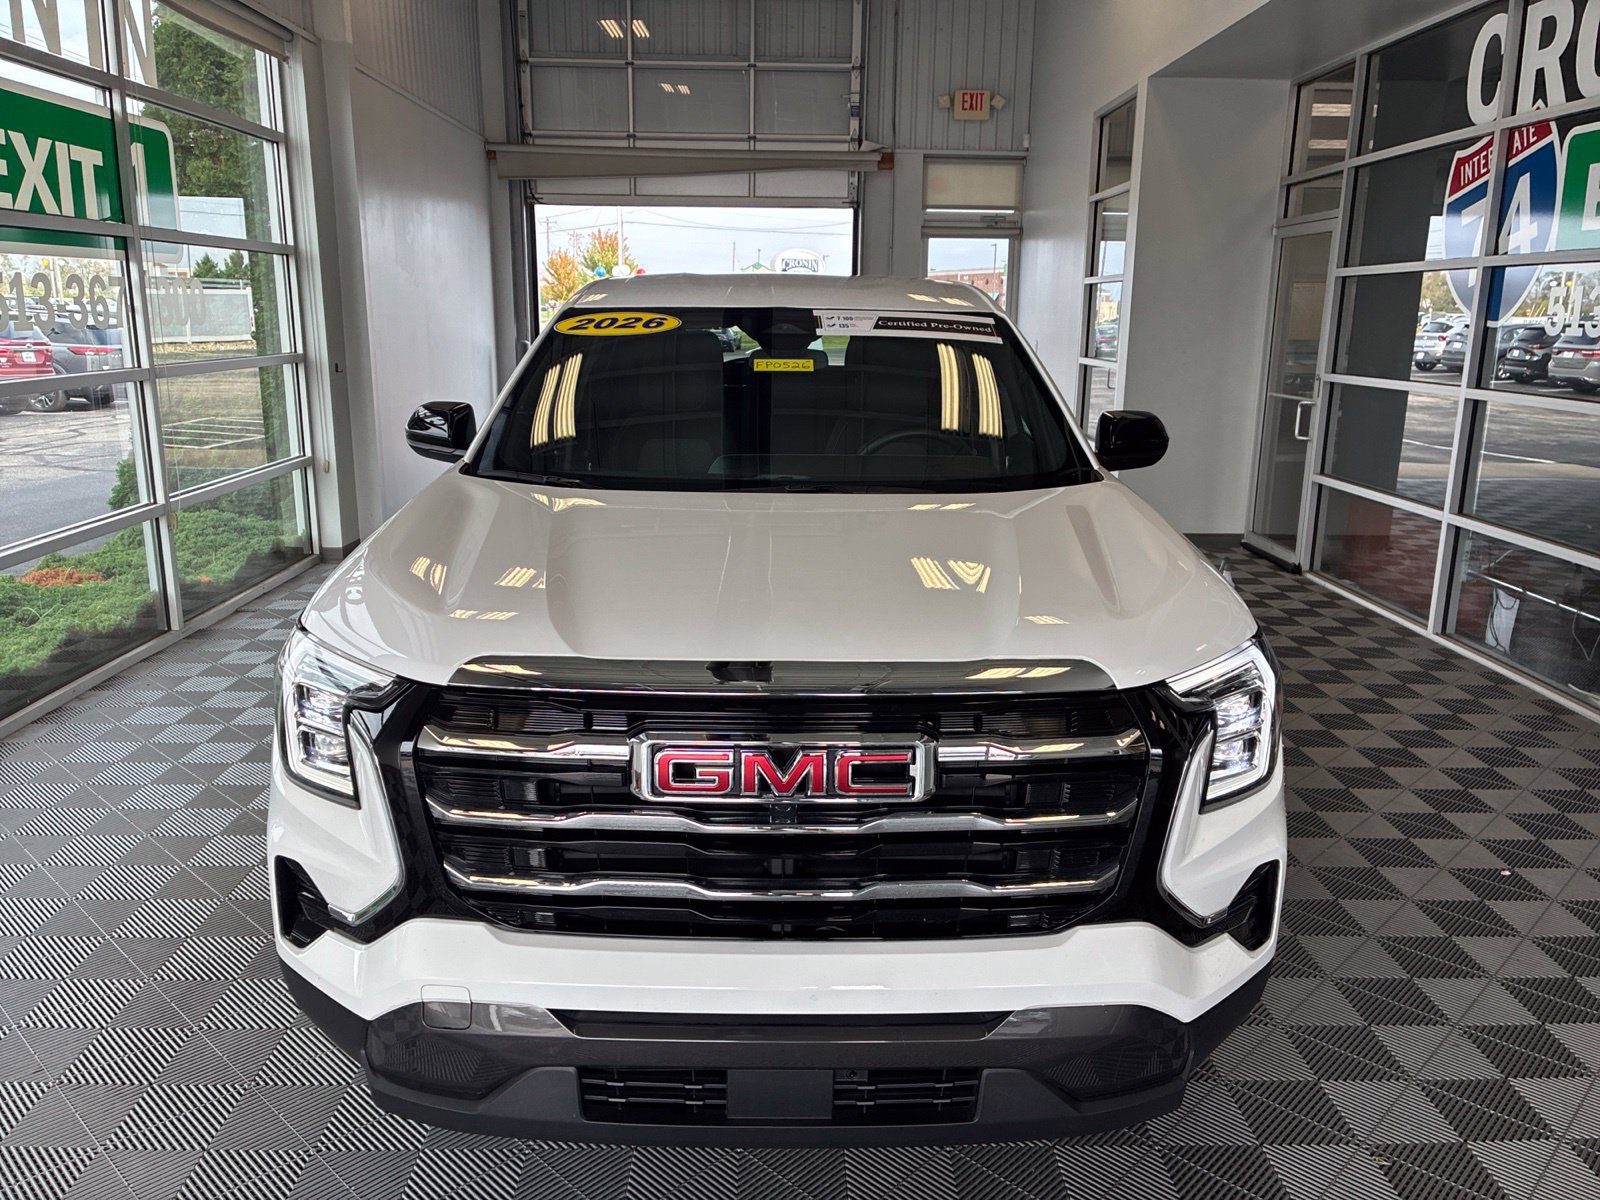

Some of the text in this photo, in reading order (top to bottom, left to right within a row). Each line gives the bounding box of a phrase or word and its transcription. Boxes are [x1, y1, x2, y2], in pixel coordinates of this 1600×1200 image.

[961, 92, 985, 111] EXIT
[782, 258, 819, 272] CRONIN
[566, 317, 668, 331] 2026
[878, 320, 992, 333] Certified Pre-Owned
[654, 750, 913, 797] GMC
